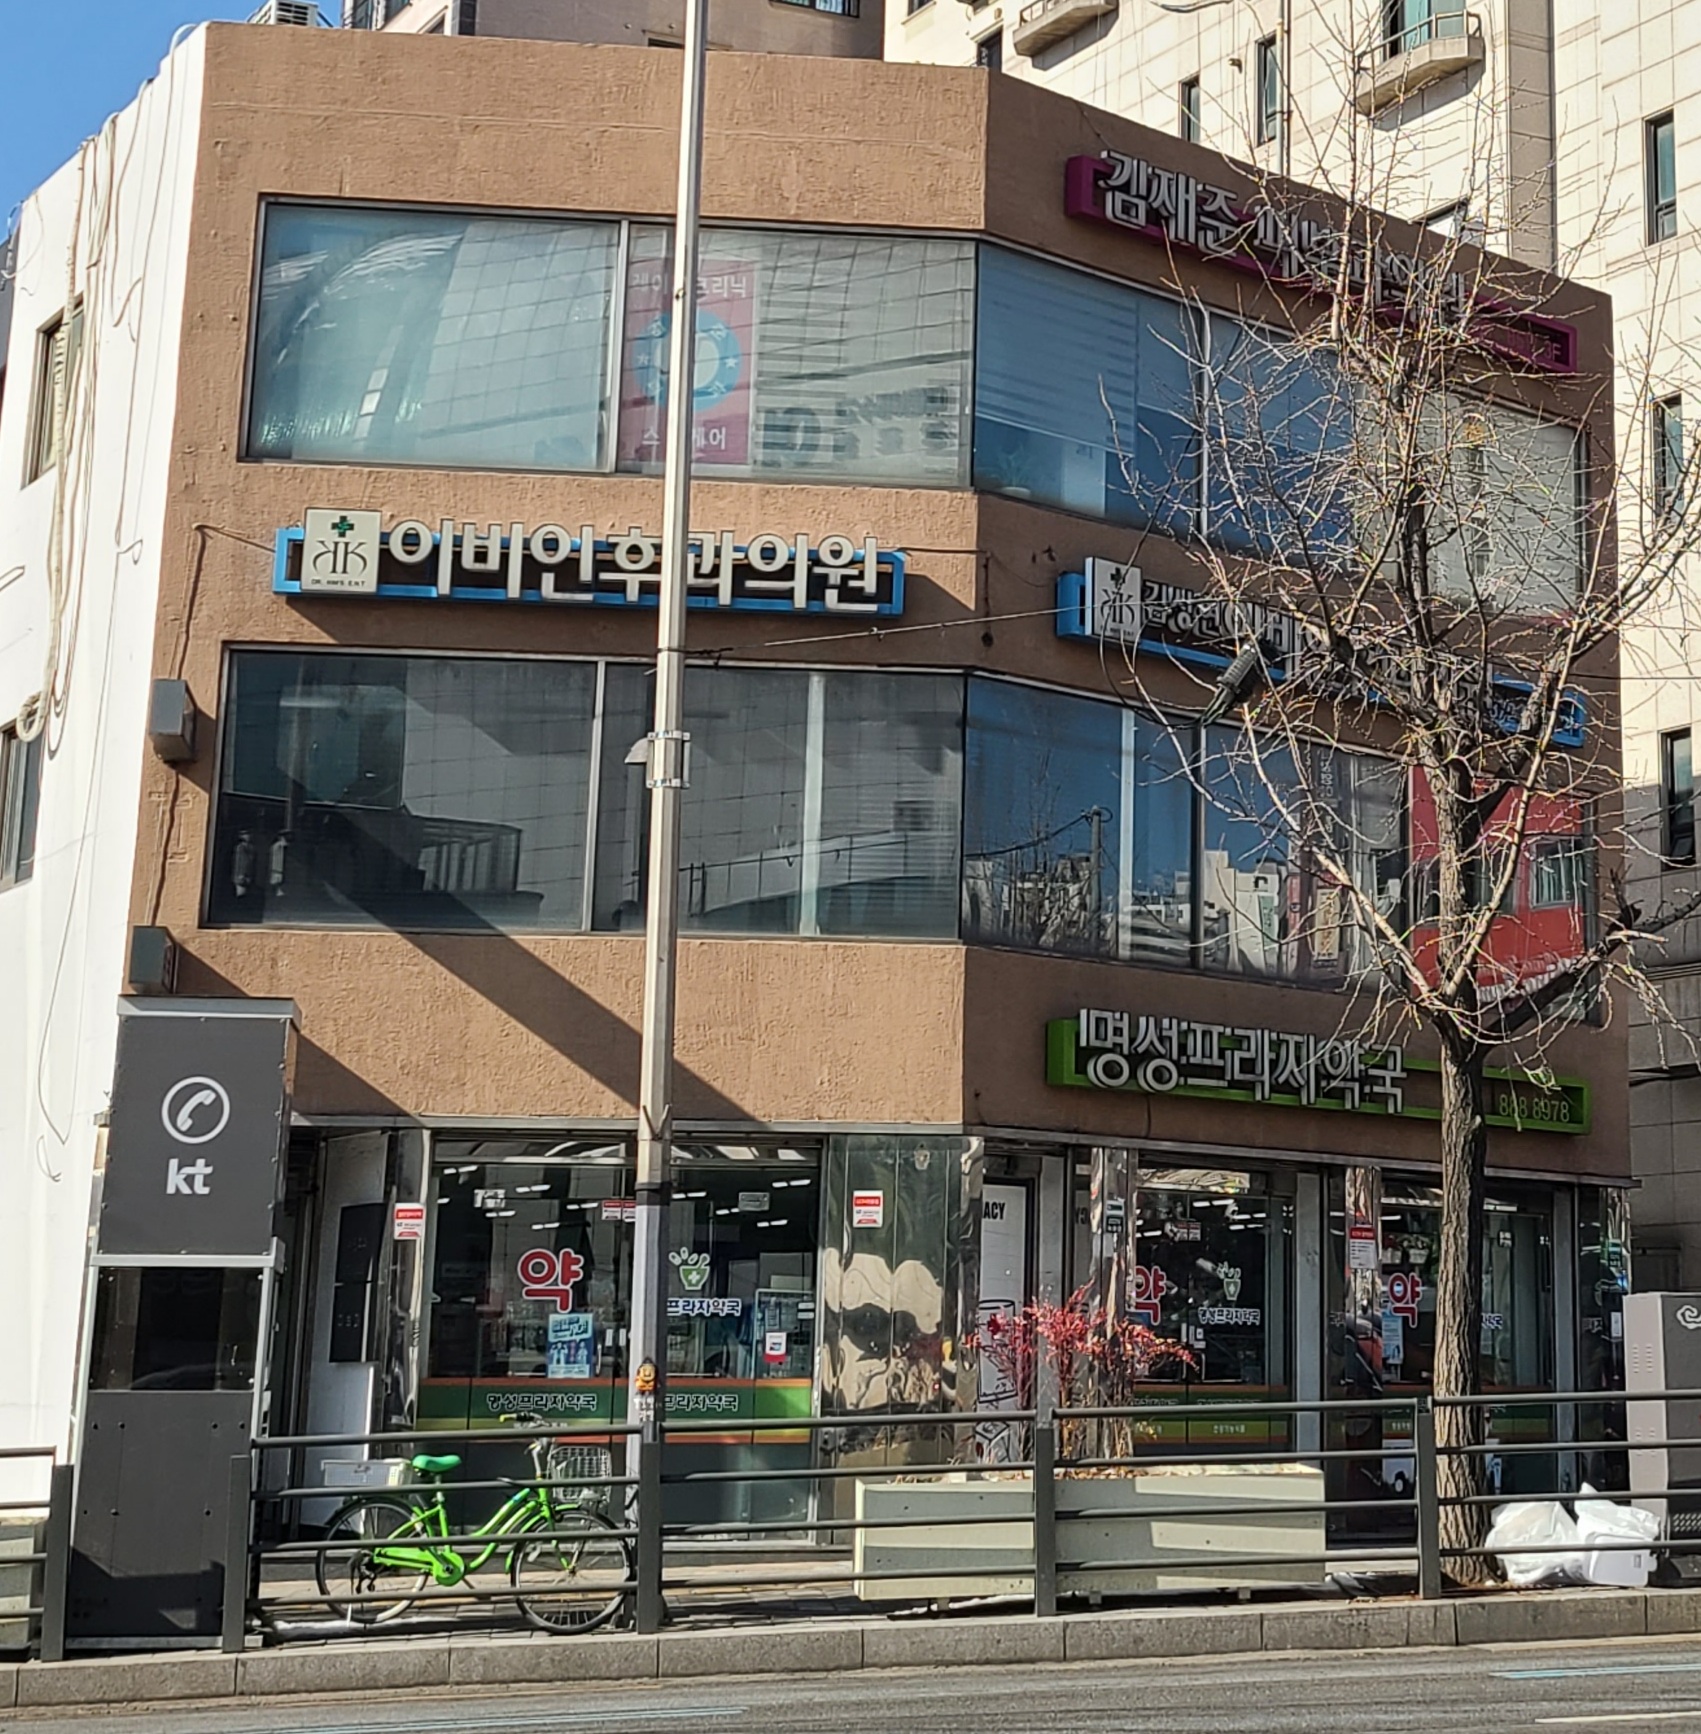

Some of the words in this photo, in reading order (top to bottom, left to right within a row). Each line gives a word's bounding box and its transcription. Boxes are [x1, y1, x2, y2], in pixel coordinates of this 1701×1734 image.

[1098, 150, 1240, 260] 김재준
[387, 518, 878, 612] 이비인후과의원
[1078, 1008, 1407, 1114] 명성프라자약국
[1532, 1097, 1570, 1123] 8978
[166, 1158, 213, 1195] kt
[517, 1248, 584, 1313] 약
[1388, 1273, 1421, 1328] 약
